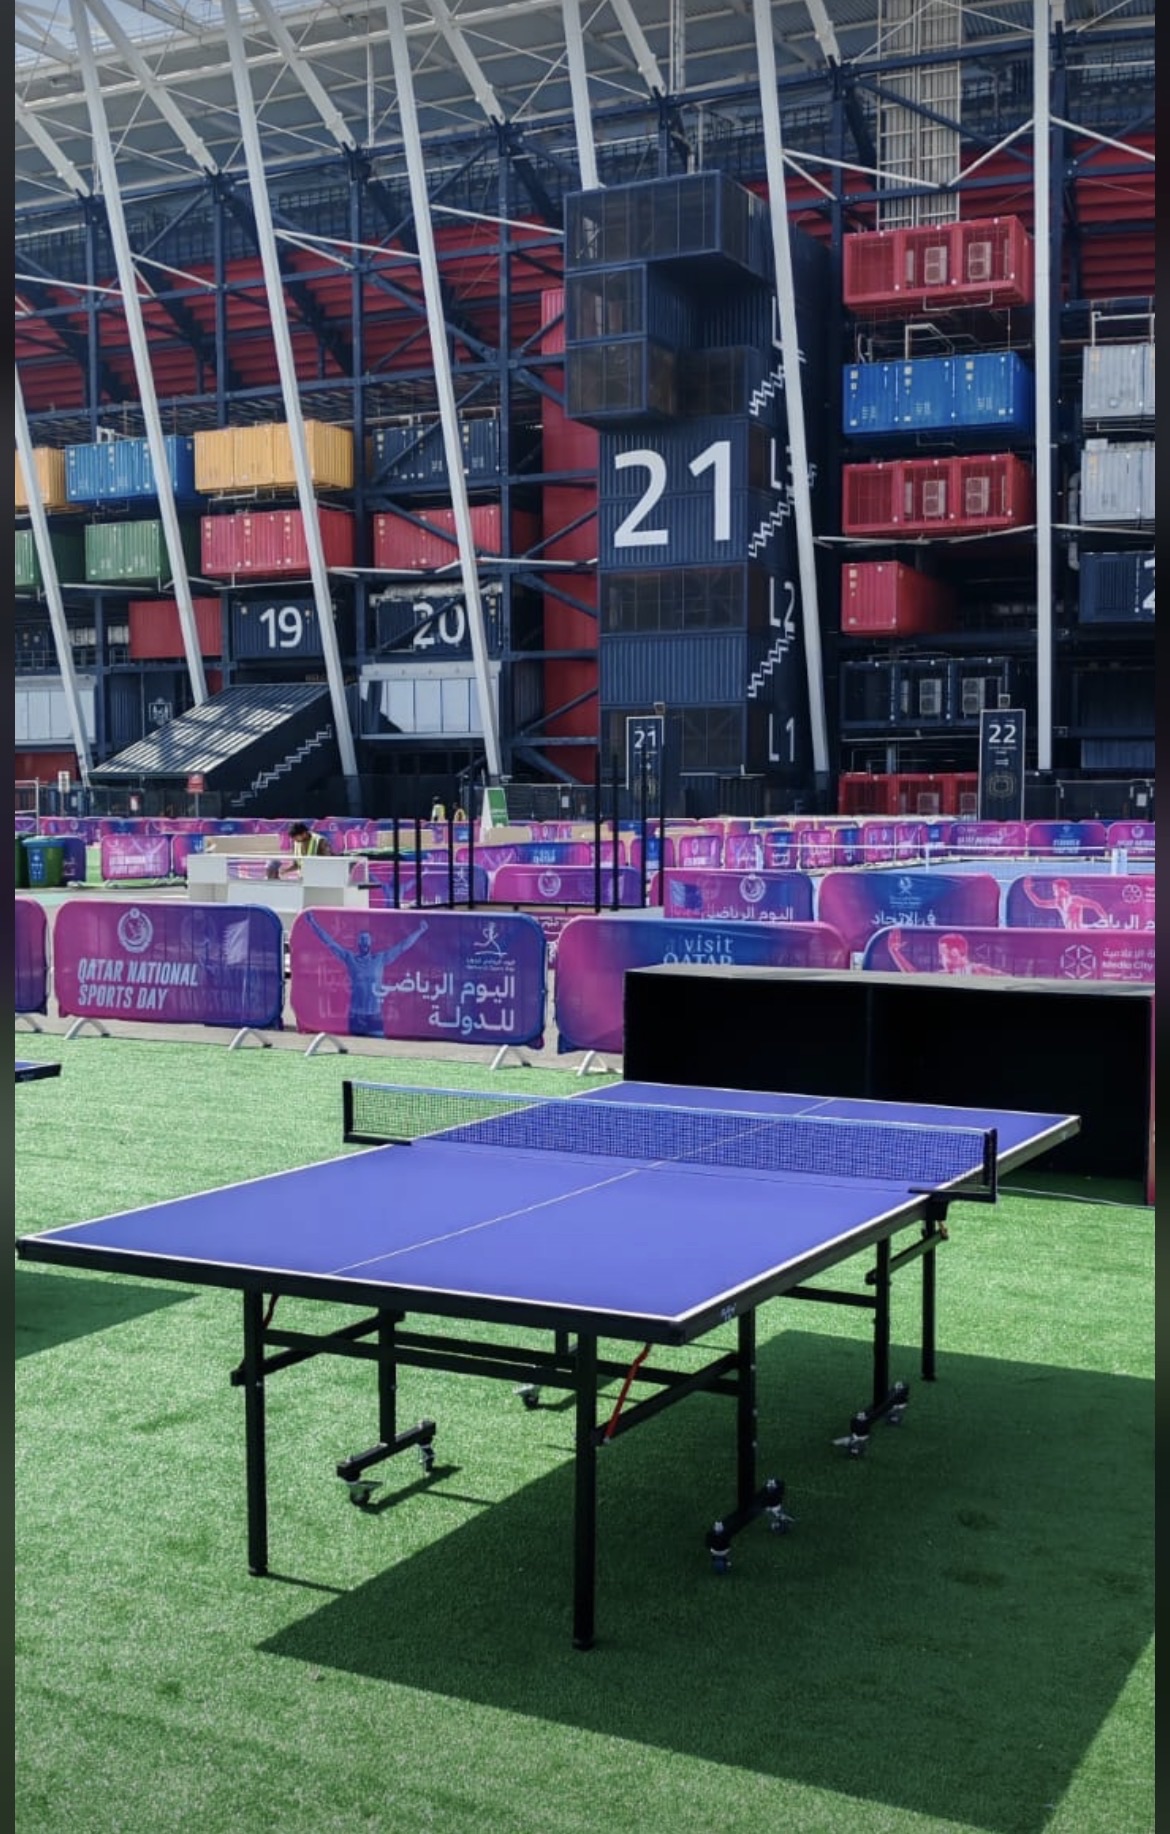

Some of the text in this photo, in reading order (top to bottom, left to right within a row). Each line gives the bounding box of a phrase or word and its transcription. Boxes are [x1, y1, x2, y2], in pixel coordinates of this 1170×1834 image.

[614, 440, 731, 549] 21
[769, 576, 796, 633] L2
[259, 605, 303, 649] 19
[412, 601, 466, 647] 20
[633, 729, 657, 749] 21
[769, 713, 796, 763] L1
[988, 724, 1017, 744] 22
[684, 933, 735, 954] visit
[78, 958, 199, 987] QATAR NATIONAL
[371, 971, 516, 1004] اليوم الرياضي
[78, 984, 169, 1011] SPORTS DAY
